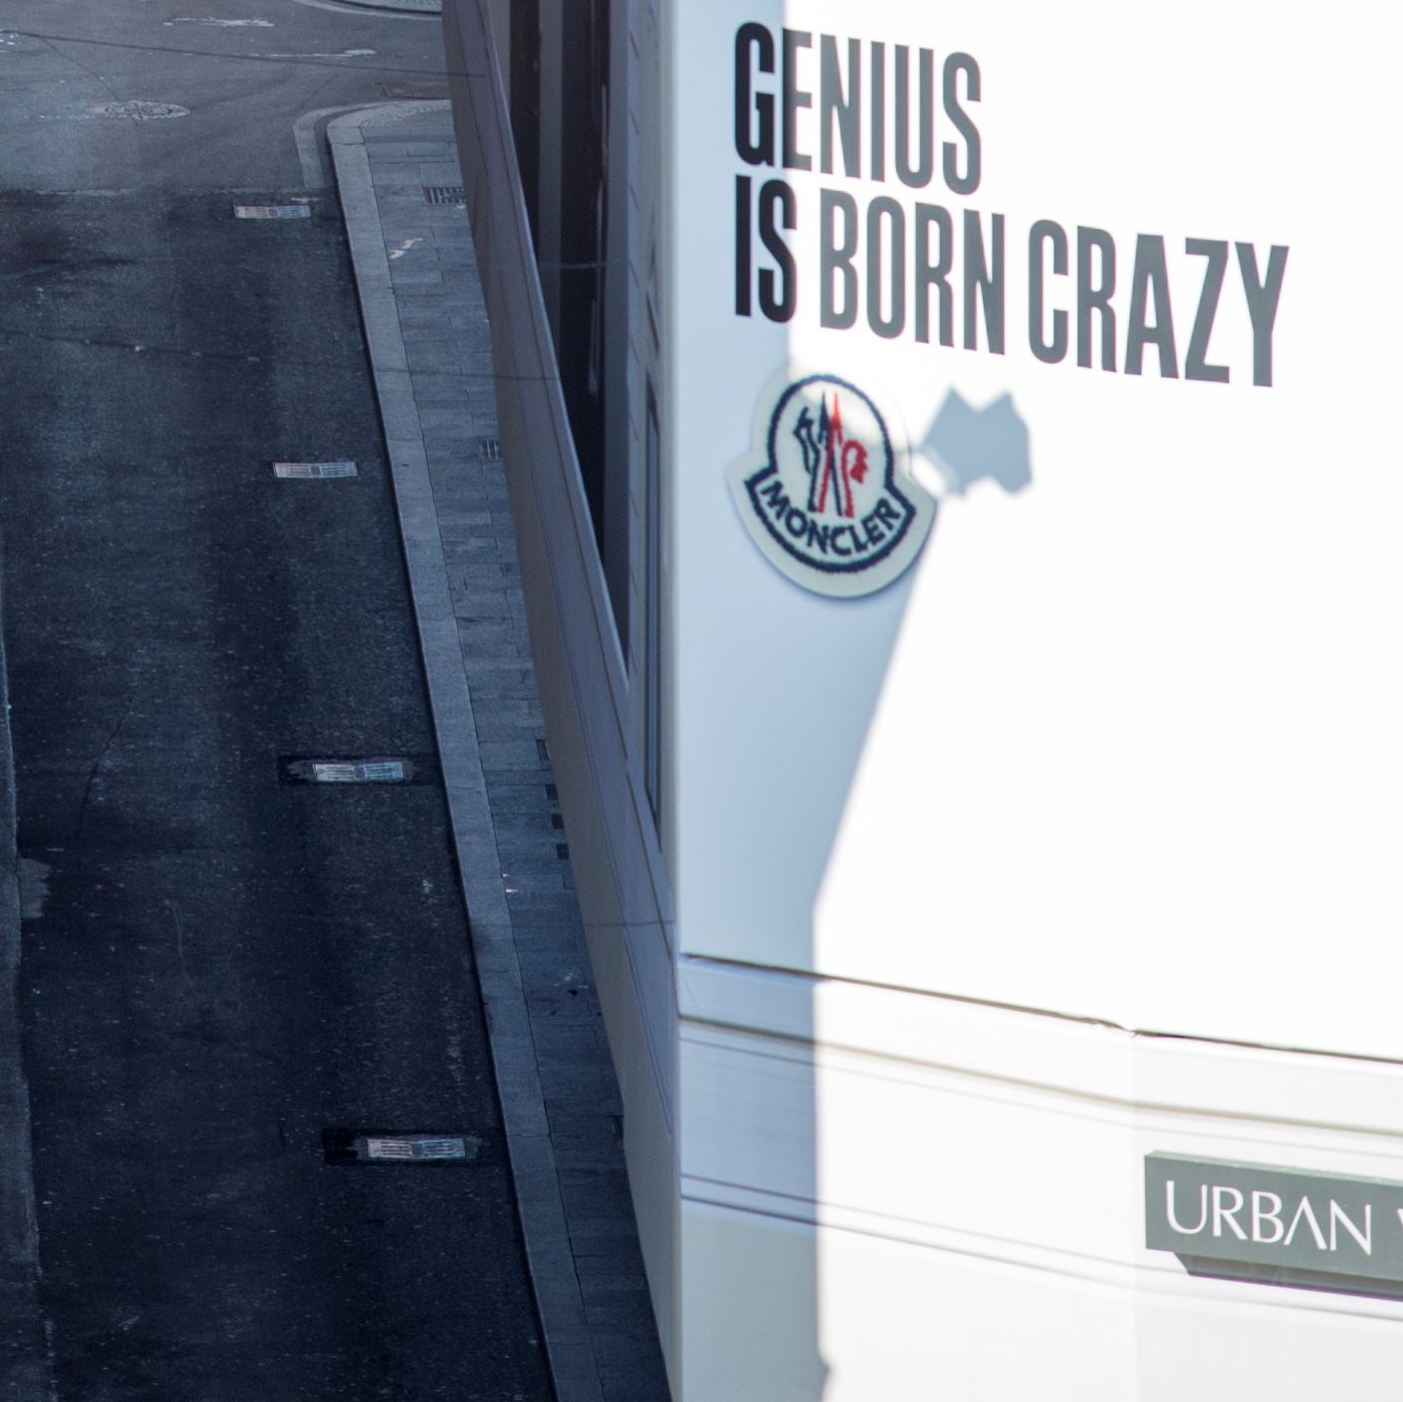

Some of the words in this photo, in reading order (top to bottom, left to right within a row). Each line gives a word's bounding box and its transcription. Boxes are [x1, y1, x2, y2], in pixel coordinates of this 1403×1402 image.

[733, 20, 982, 195] GENIUS
[734, 173, 797, 325] IS
[820, 188, 1006, 356] BORN
[1027, 218, 1290, 388] CRAZY
[760, 480, 900, 556] MONCLER
[1166, 1180, 1372, 1256] URBAN
